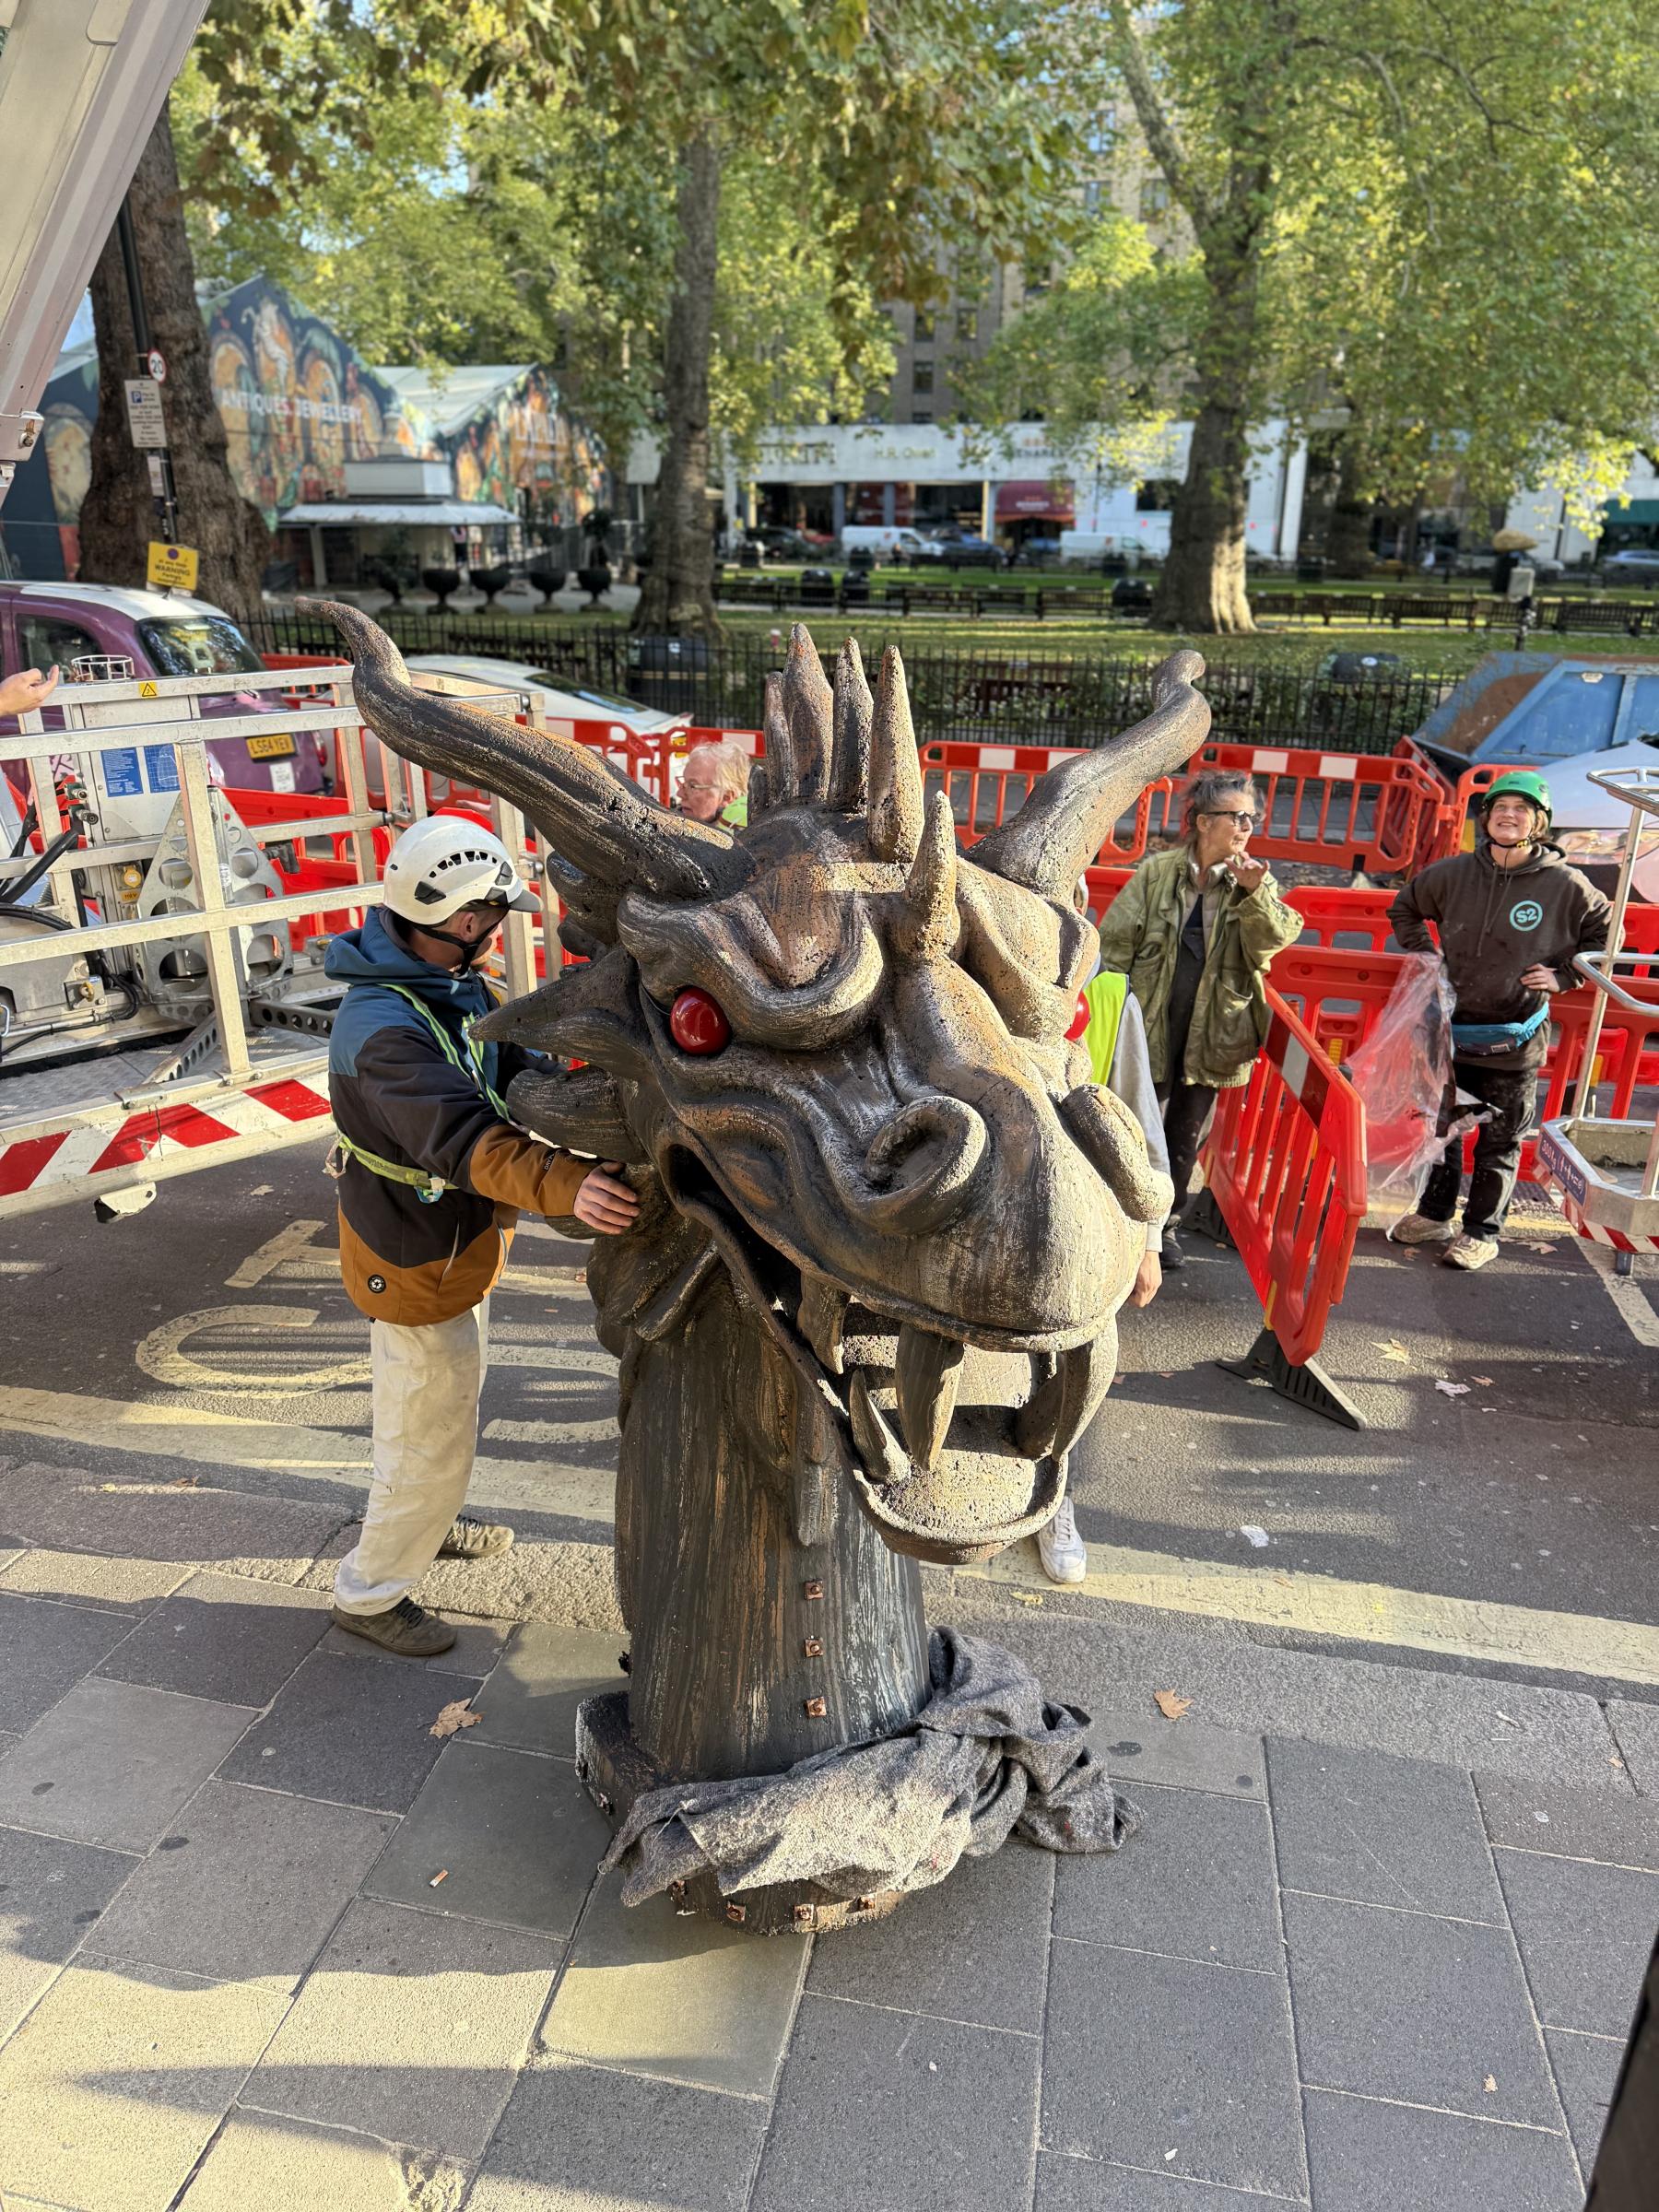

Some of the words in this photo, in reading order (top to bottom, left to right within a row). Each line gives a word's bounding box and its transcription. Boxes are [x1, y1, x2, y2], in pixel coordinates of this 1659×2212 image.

[151, 359, 164, 374] 20
[155, 564, 190, 576] WARNING
[1516, 908, 1537, 924] S2
